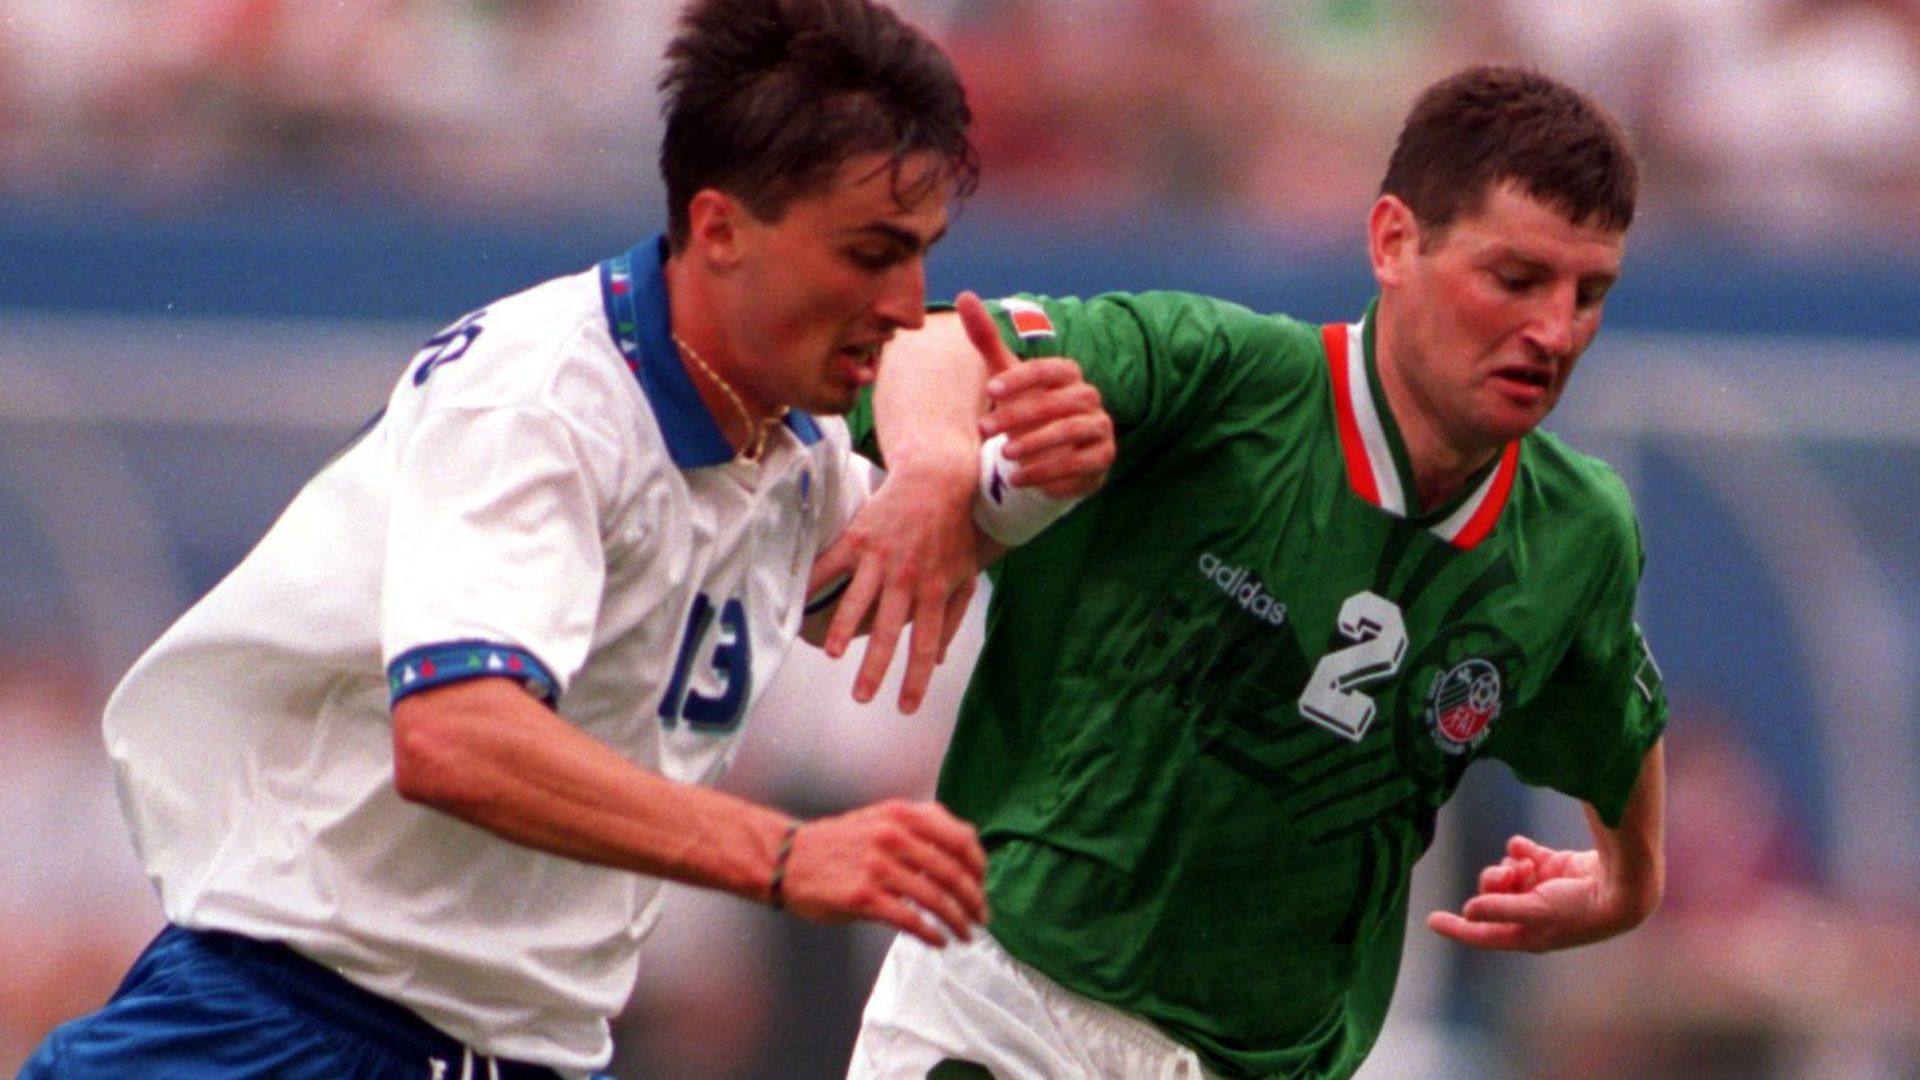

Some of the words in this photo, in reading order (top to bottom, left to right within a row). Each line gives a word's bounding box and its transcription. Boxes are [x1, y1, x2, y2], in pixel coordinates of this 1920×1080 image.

[1199, 552, 1288, 625] adidas
[657, 591, 752, 736] 13
[1298, 589, 1410, 743] 2
